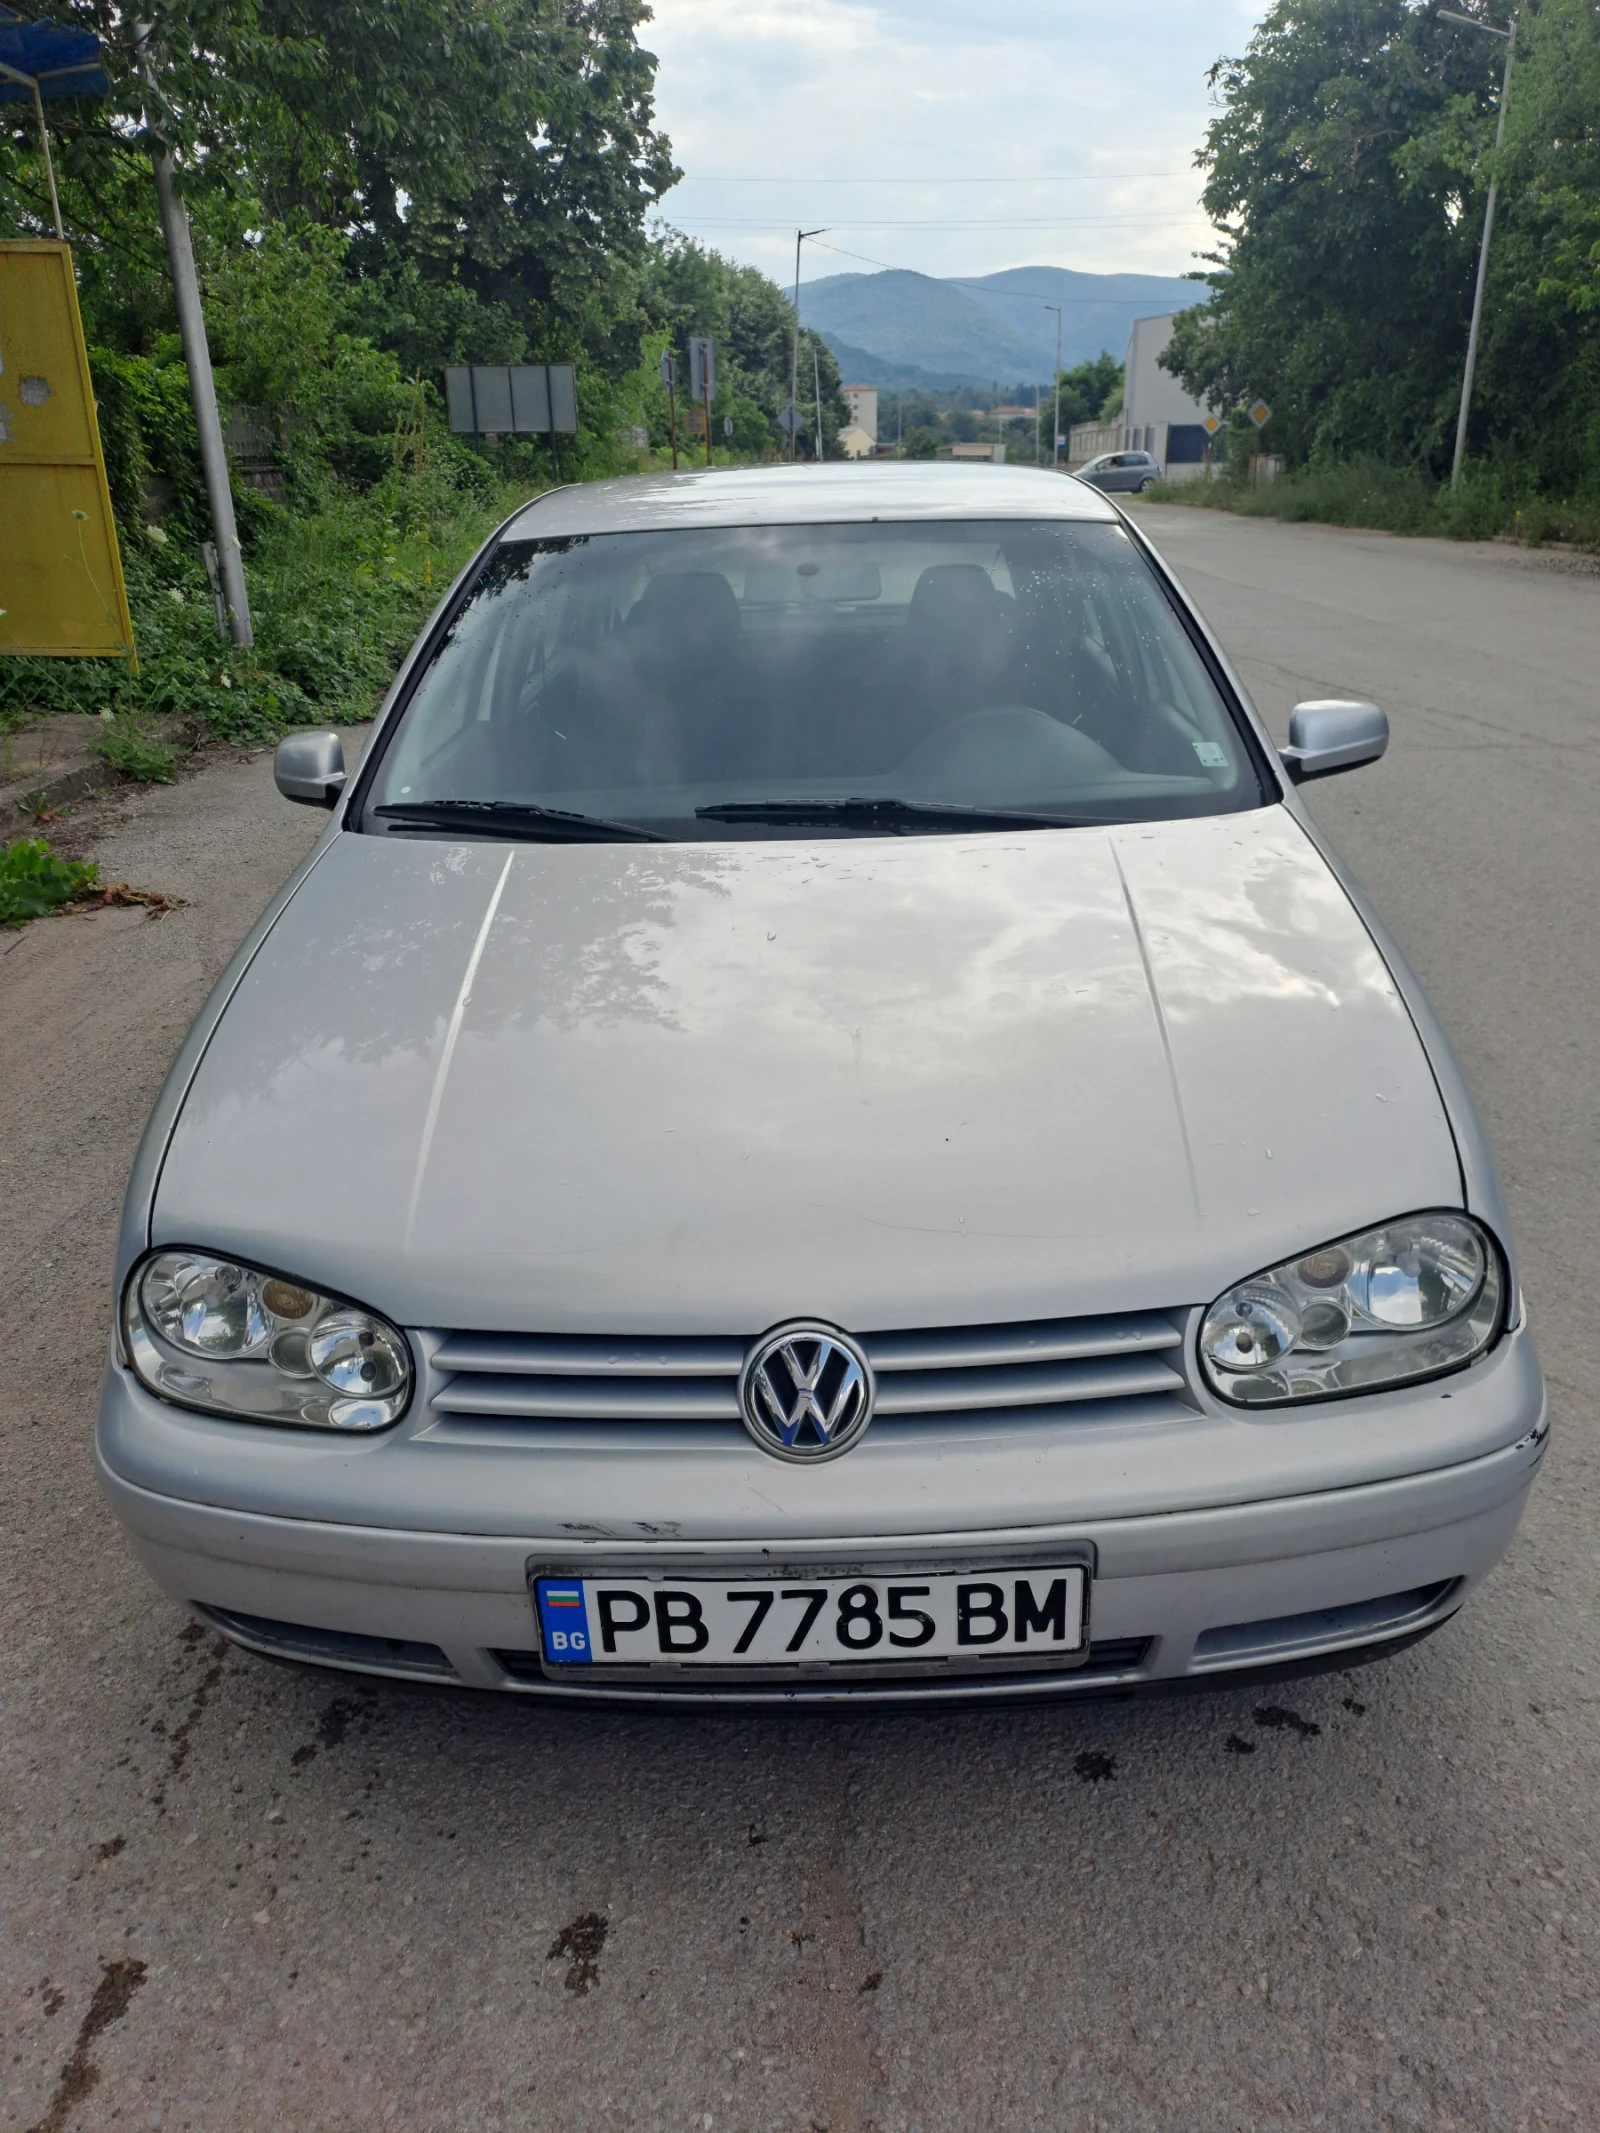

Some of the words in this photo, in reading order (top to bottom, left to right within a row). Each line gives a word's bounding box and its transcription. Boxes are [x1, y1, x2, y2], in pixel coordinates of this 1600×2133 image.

[597, 1590, 709, 1654] PB
[727, 1584, 936, 1653] 7785
[957, 1579, 1067, 1646] BM
[552, 1631, 586, 1650] BG
